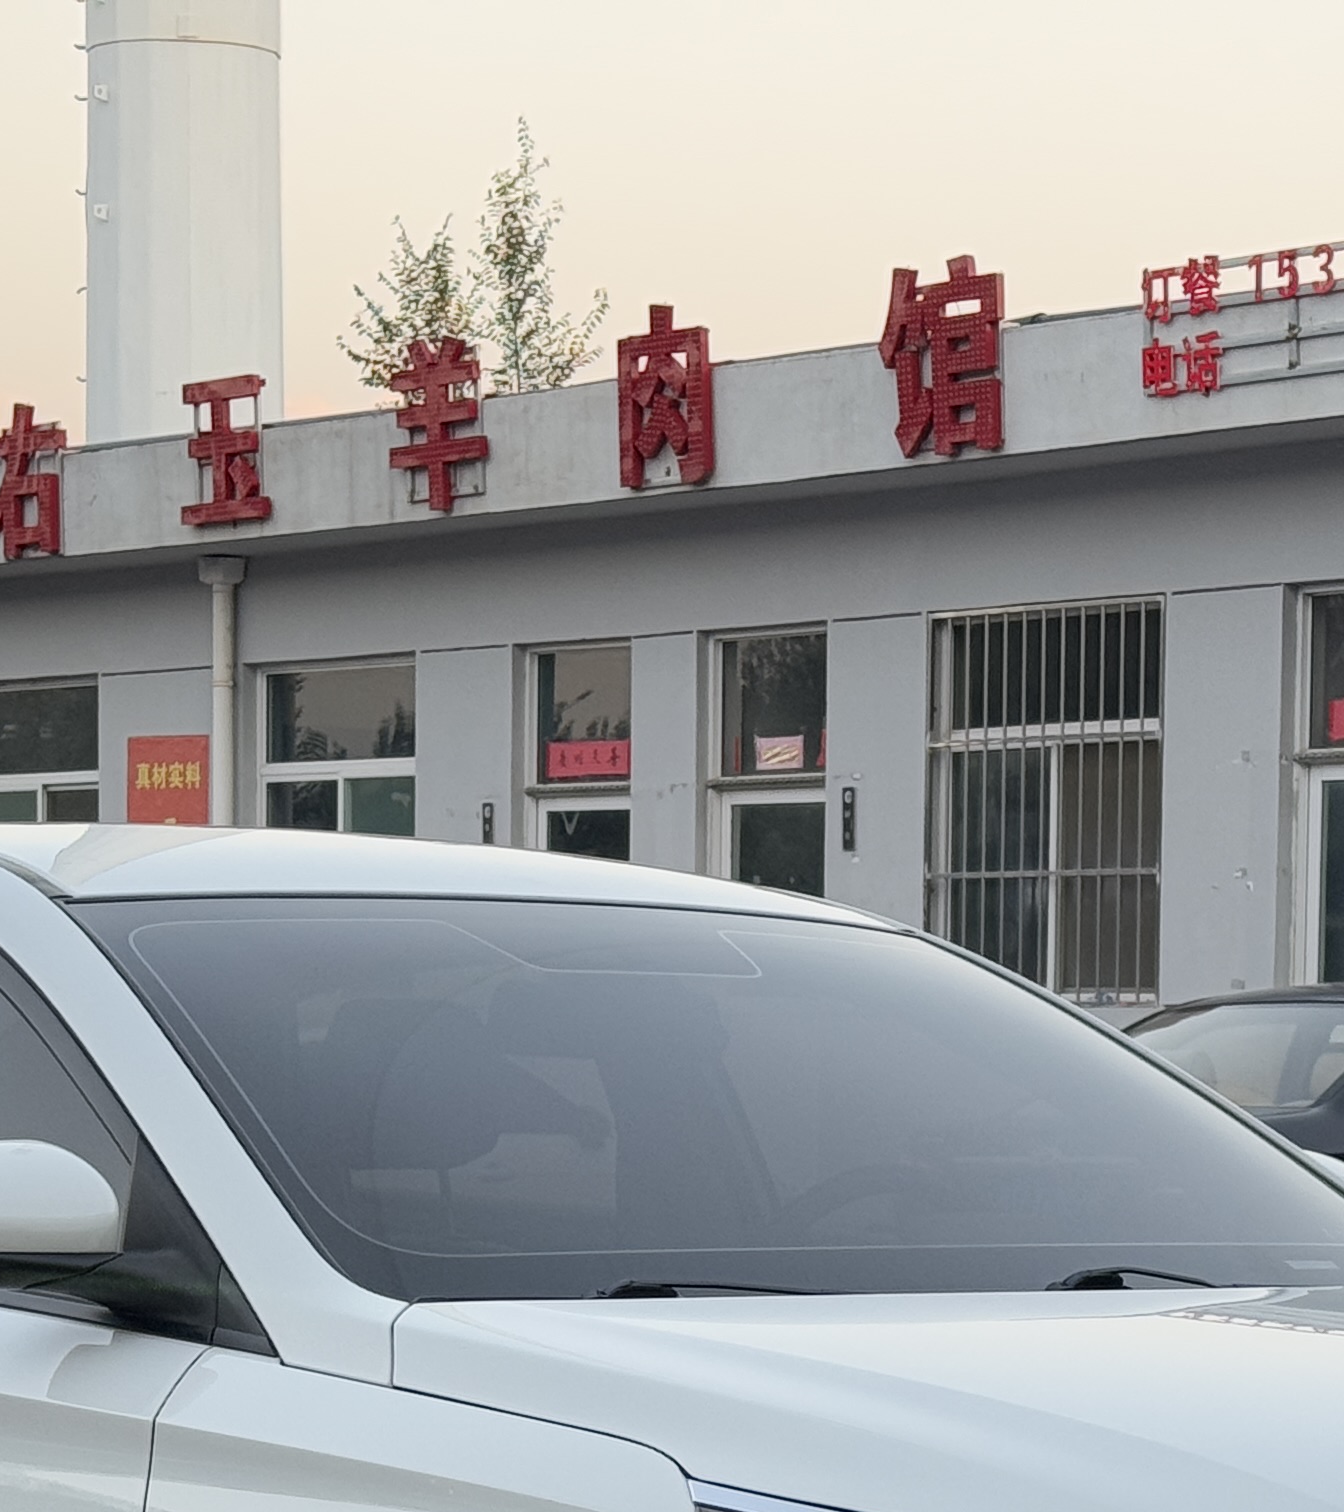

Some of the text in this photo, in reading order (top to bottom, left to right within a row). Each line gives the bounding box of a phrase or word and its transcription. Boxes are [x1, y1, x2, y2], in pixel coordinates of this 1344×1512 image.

[1142, 330, 1223, 396] 电话
[135, 760, 201, 790] 真材实料
